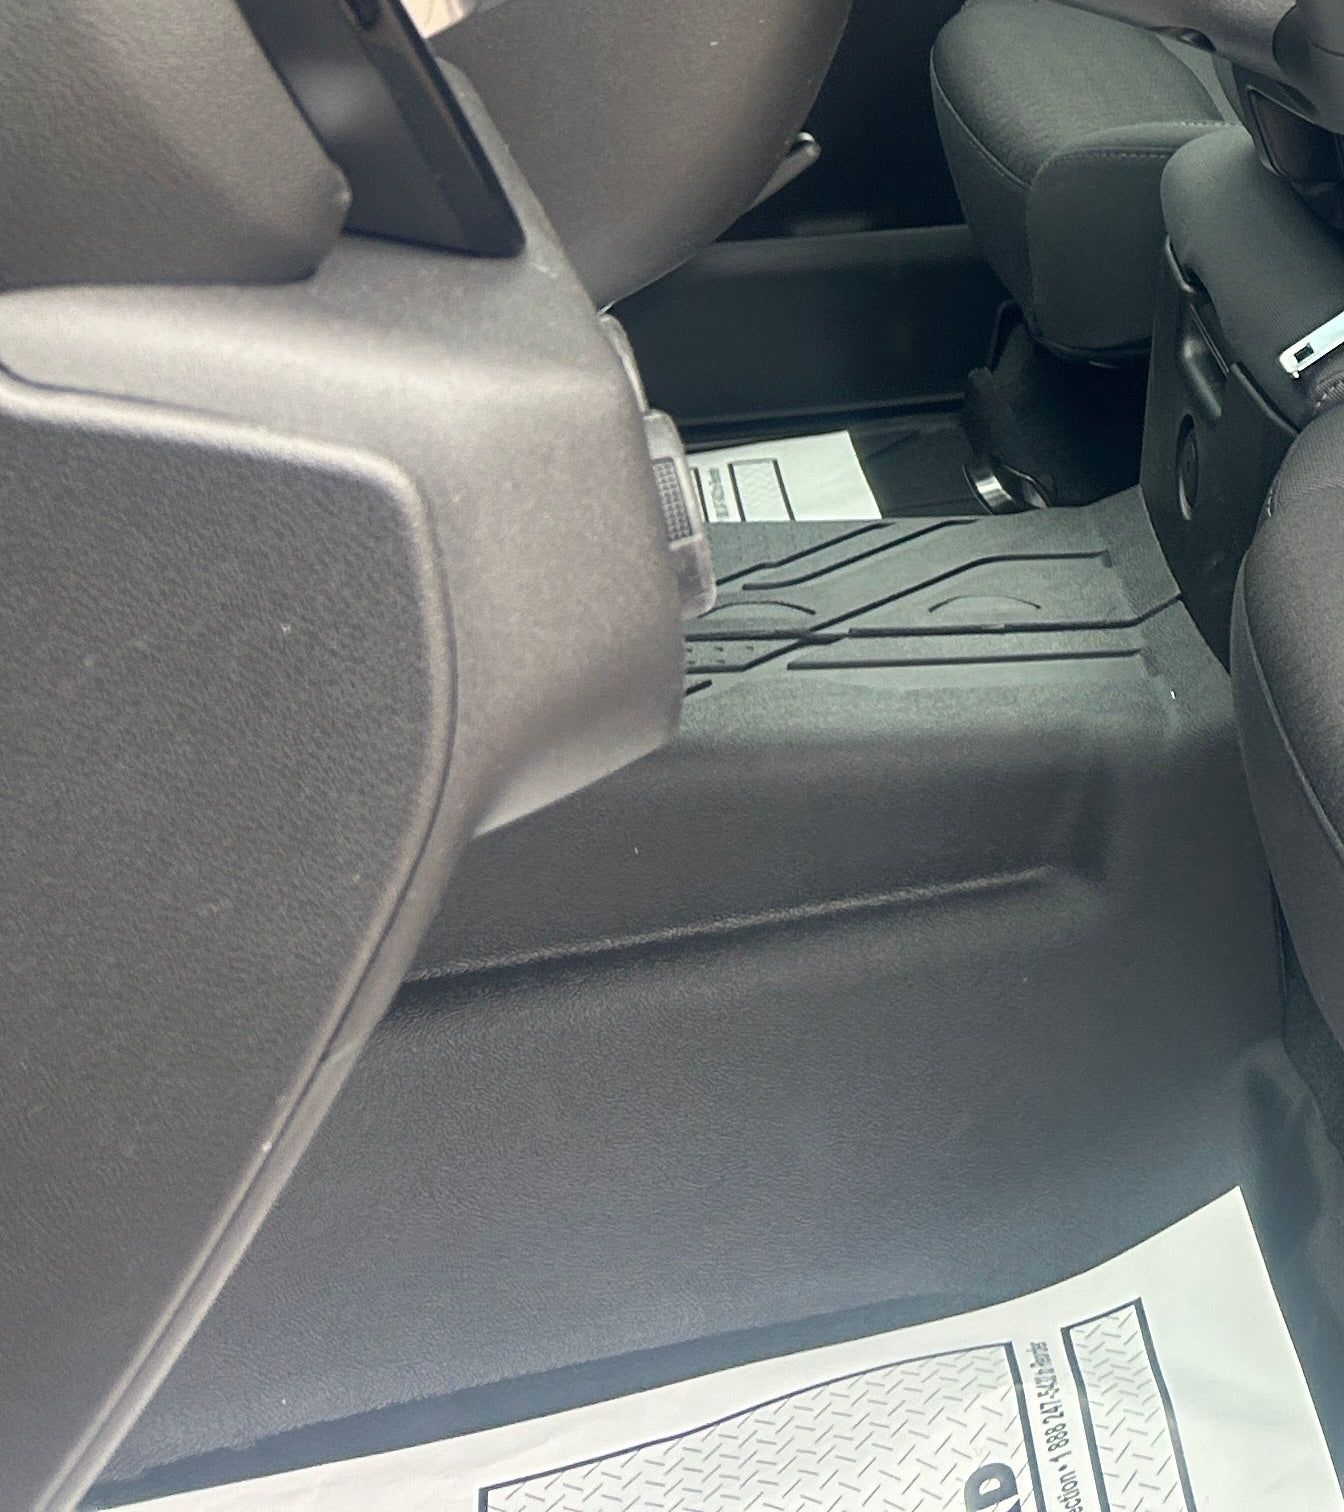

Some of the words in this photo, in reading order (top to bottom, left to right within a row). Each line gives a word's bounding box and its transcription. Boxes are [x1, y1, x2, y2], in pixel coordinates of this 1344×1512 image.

[1044, 1422, 1069, 1452] 888
[1049, 1450, 1072, 1463] 1
[964, 1462, 1022, 1512] D
